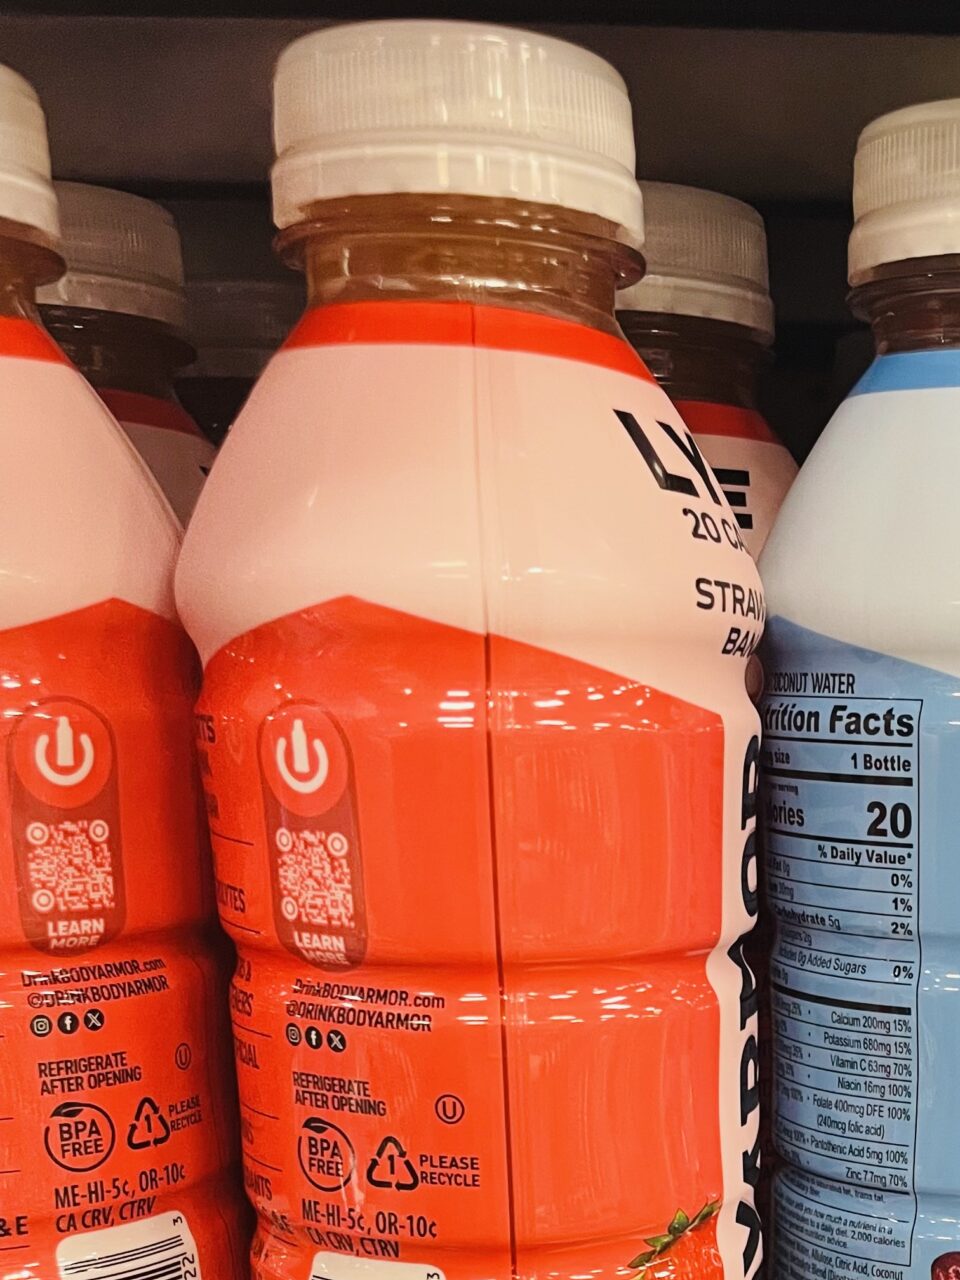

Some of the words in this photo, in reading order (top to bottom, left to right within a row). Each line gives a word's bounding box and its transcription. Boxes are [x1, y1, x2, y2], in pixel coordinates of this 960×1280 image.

[682, 508, 721, 543] 20
[811, 673, 855, 694] WATER
[829, 705, 914, 737] Facts
[863, 754, 911, 772] Bottle
[866, 801, 912, 838] 20
[830, 846, 862, 865] Daily
[890, 873, 913, 888] 0%
[891, 897, 913, 912] 1%
[47, 918, 105, 937] LEARN
[890, 921, 913, 936] 2%
[293, 930, 346, 953] LEARN
[833, 958, 867, 975] Sugars
[892, 965, 914, 980] 0%
[831, 1011, 861, 1027] Calcium
[862, 1015, 891, 1034] 200mg
[893, 1018, 912, 1033] 15%
[38, 1052, 127, 1078] REFRIGERATE
[867, 1059, 891, 1077] 63mg
[893, 1063, 912, 1077] 70%
[40, 1077, 84, 1096] AFTER
[88, 1066, 142, 1089] OPENING
[292, 1071, 371, 1098] REFRIGERATE
[888, 1084, 911, 1098] 100%
[295, 1089, 329, 1110] AFTER
[332, 1096, 387, 1116] OPENING
[58, 1118, 102, 1143] BPA
[61, 1136, 104, 1159] FREE
[308, 1136, 343, 1160] BPA
[308, 1157, 344, 1177] FREE
[419, 1154, 480, 1171] PLEASE
[420, 1171, 481, 1188] RECYCLE
[56, 1213, 77, 1233] CA
[81, 1205, 114, 1228] CRV,
[119, 1195, 157, 1221] CTRV
[871, 1266, 903, 1280] Coconut
